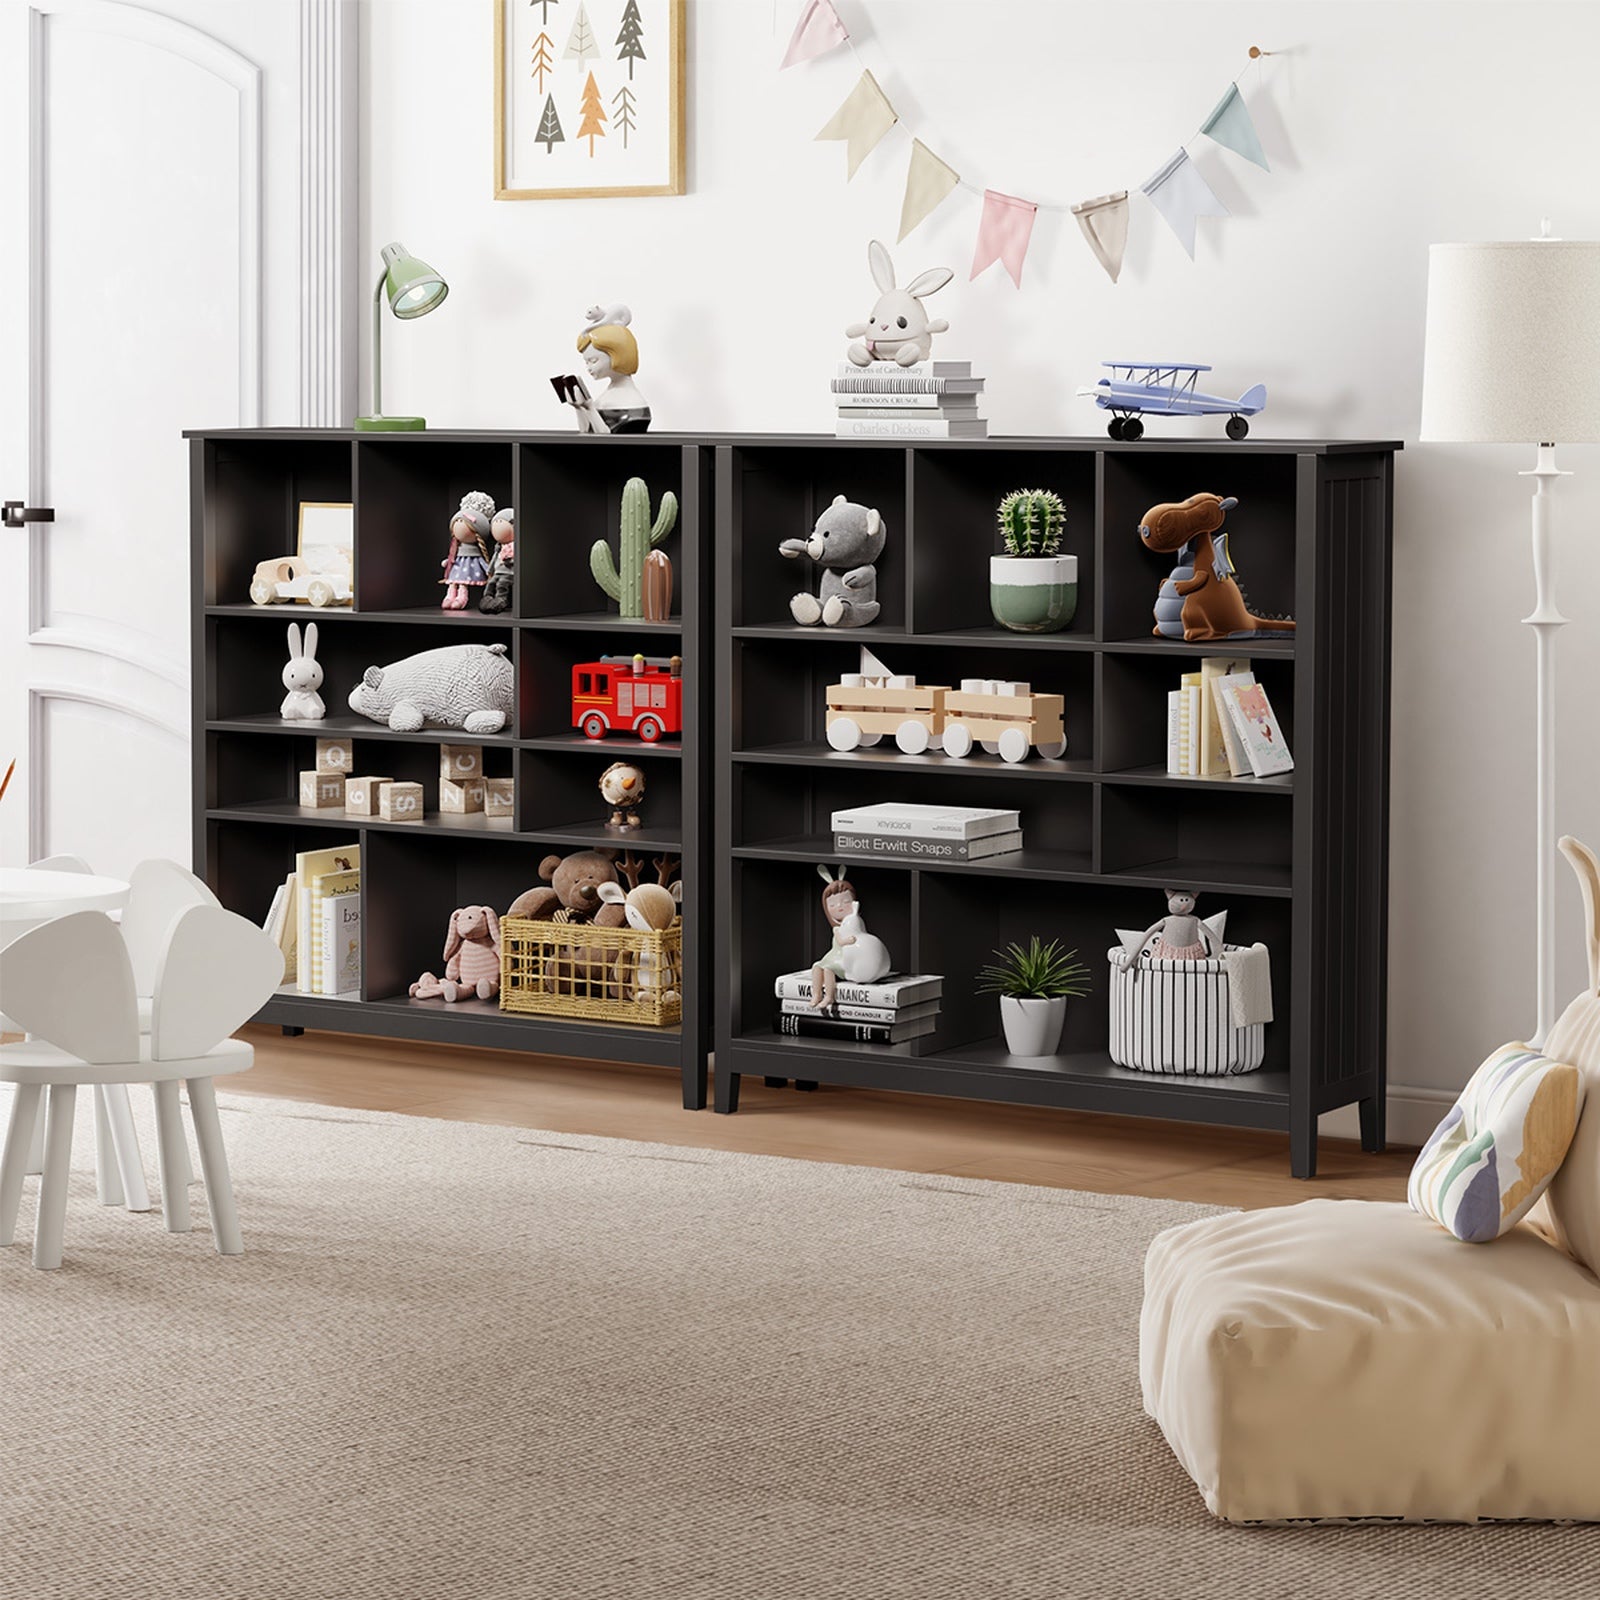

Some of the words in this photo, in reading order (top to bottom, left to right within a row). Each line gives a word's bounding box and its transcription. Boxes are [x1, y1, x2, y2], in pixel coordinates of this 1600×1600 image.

[845, 365, 874, 374] Princess
[852, 422, 889, 434] Charles
[892, 423, 930, 435] Dickens
[326, 746, 346, 768] Q
[837, 835, 870, 850] Elliott
[873, 837, 908, 853] Erwitt
[911, 840, 953, 856] Snaps
